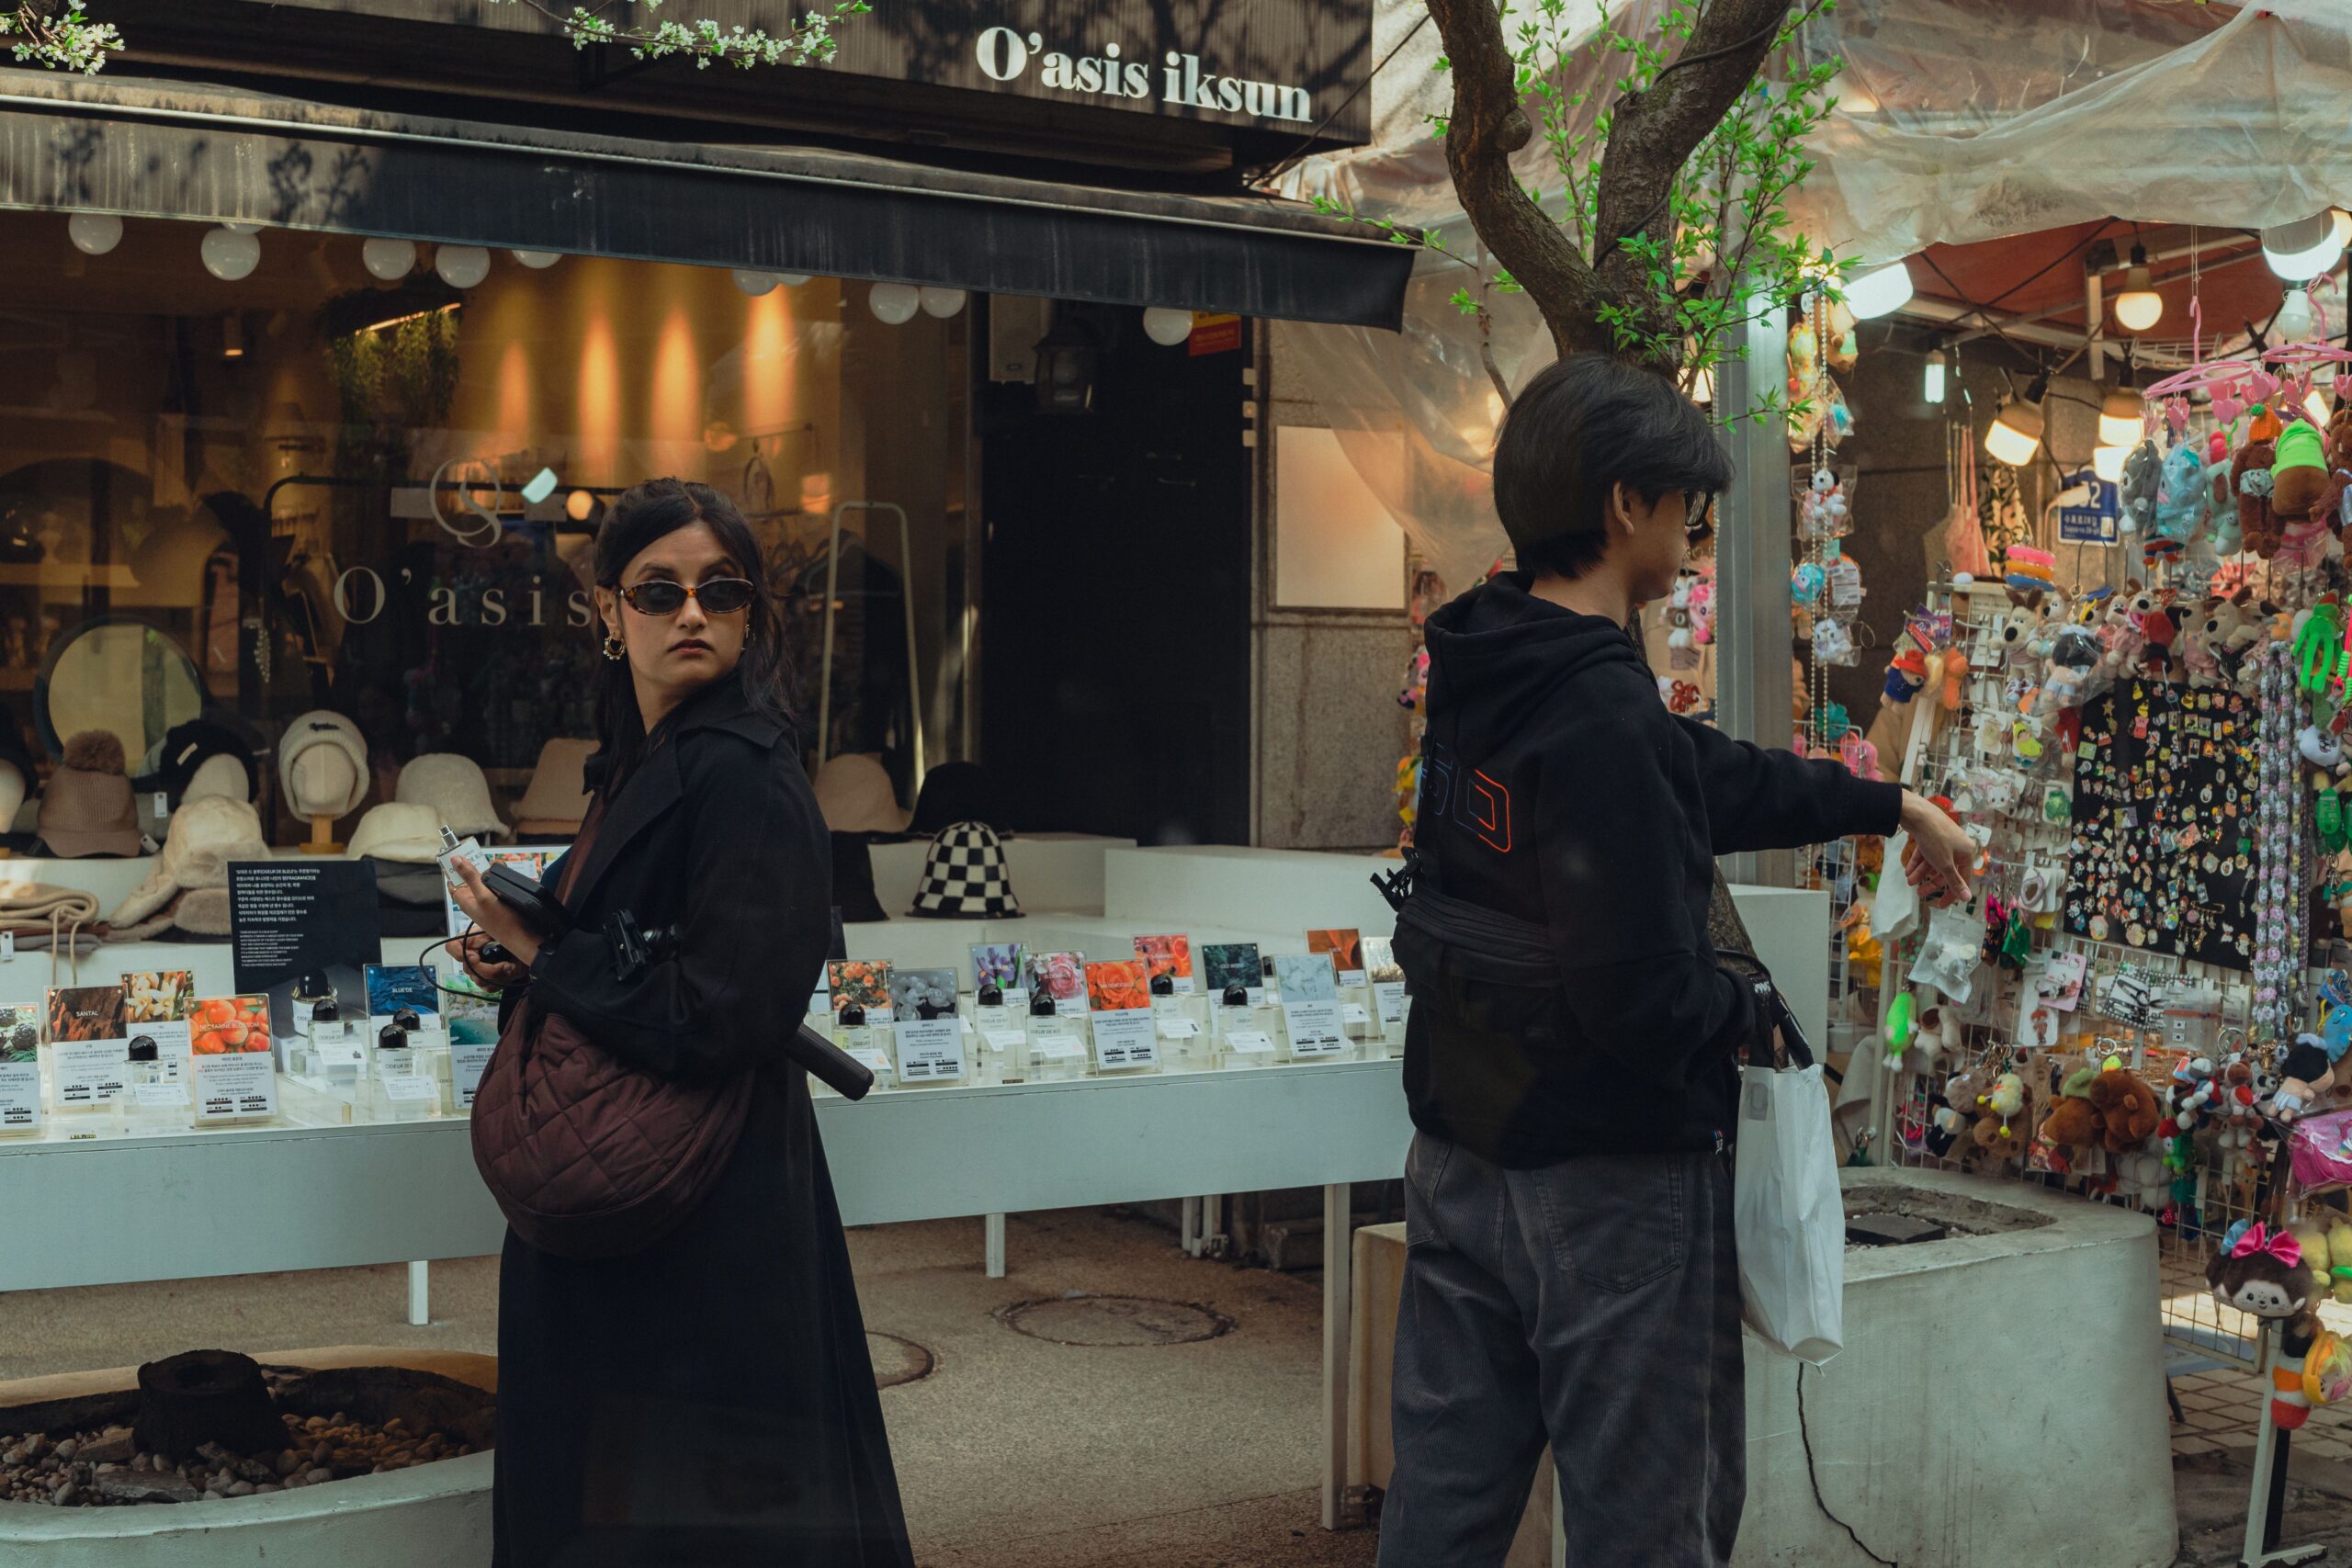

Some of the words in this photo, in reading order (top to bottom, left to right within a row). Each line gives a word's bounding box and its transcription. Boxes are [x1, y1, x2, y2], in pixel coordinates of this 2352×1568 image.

[976, 27, 1148, 98] O'asis
[1162, 51, 1313, 122] iksun
[334, 566, 592, 627] O'asis
